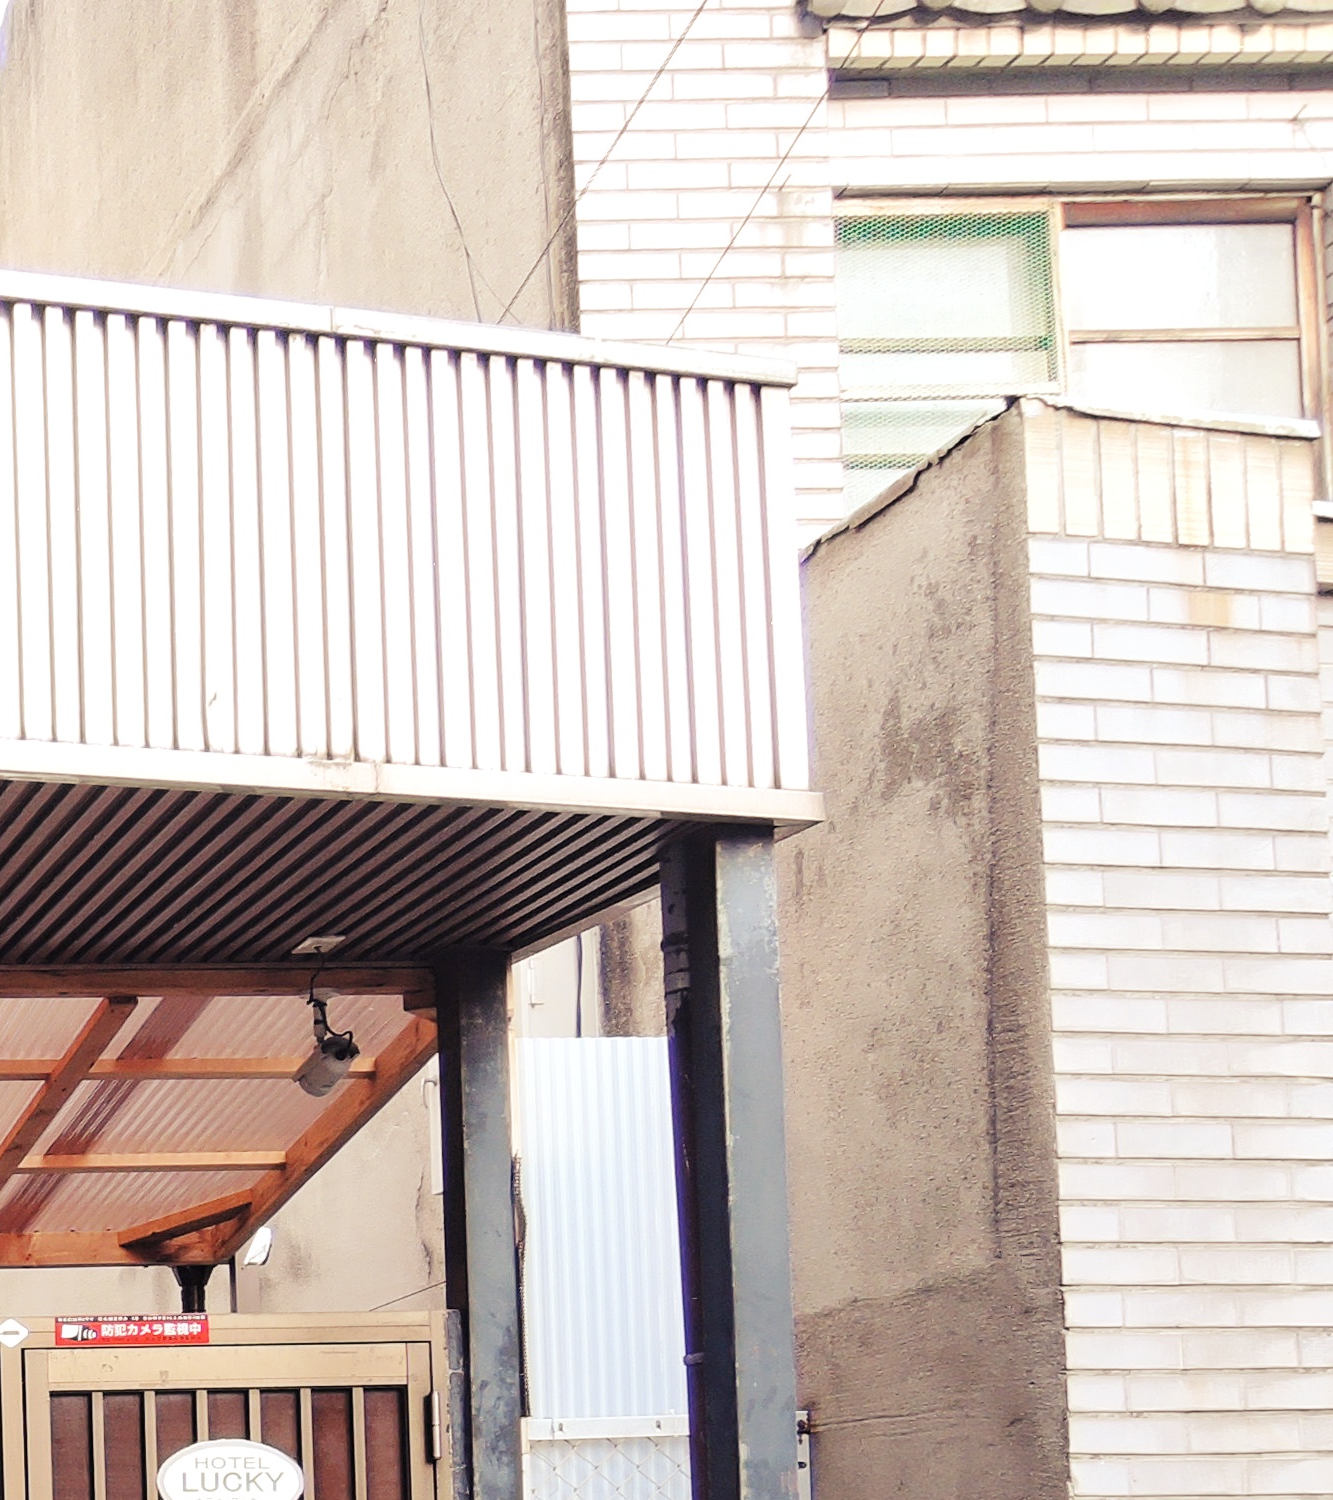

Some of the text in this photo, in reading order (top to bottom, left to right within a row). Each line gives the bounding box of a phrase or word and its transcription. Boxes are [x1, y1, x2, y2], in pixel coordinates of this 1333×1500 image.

[101, 1323, 202, 1336] 防犯カメラ監視中
[195, 1457, 271, 1469] HOTEL
[182, 1472, 284, 1492] LUCKY
